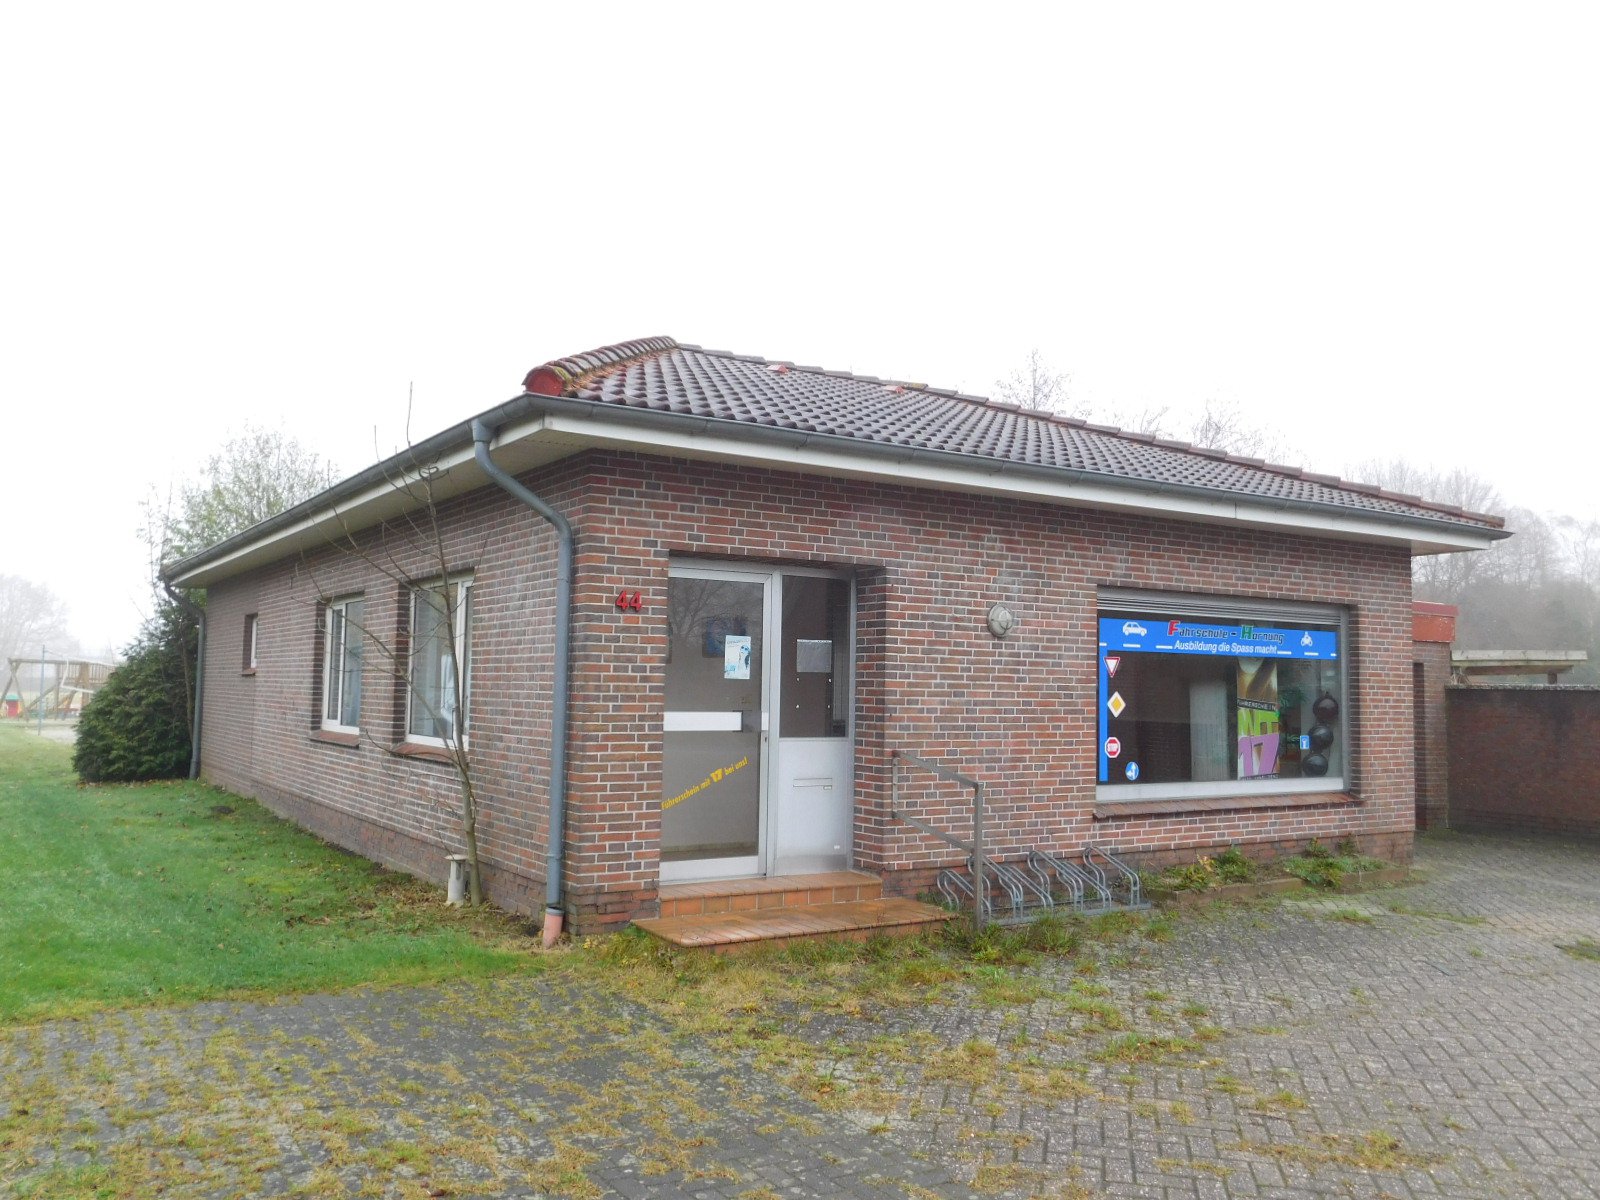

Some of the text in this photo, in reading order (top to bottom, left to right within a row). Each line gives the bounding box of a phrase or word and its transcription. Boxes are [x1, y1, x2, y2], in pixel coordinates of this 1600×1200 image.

[615, 591, 642, 612] 44
[1167, 620, 1228, 638] Fahrschule
[1241, 625, 1285, 645] Hornung
[1174, 640, 1277, 654] Ausbildung die Spass macht
[661, 785, 700, 810] Führerschein
[700, 778, 711, 790] mit
[724, 764, 735, 776] bei
